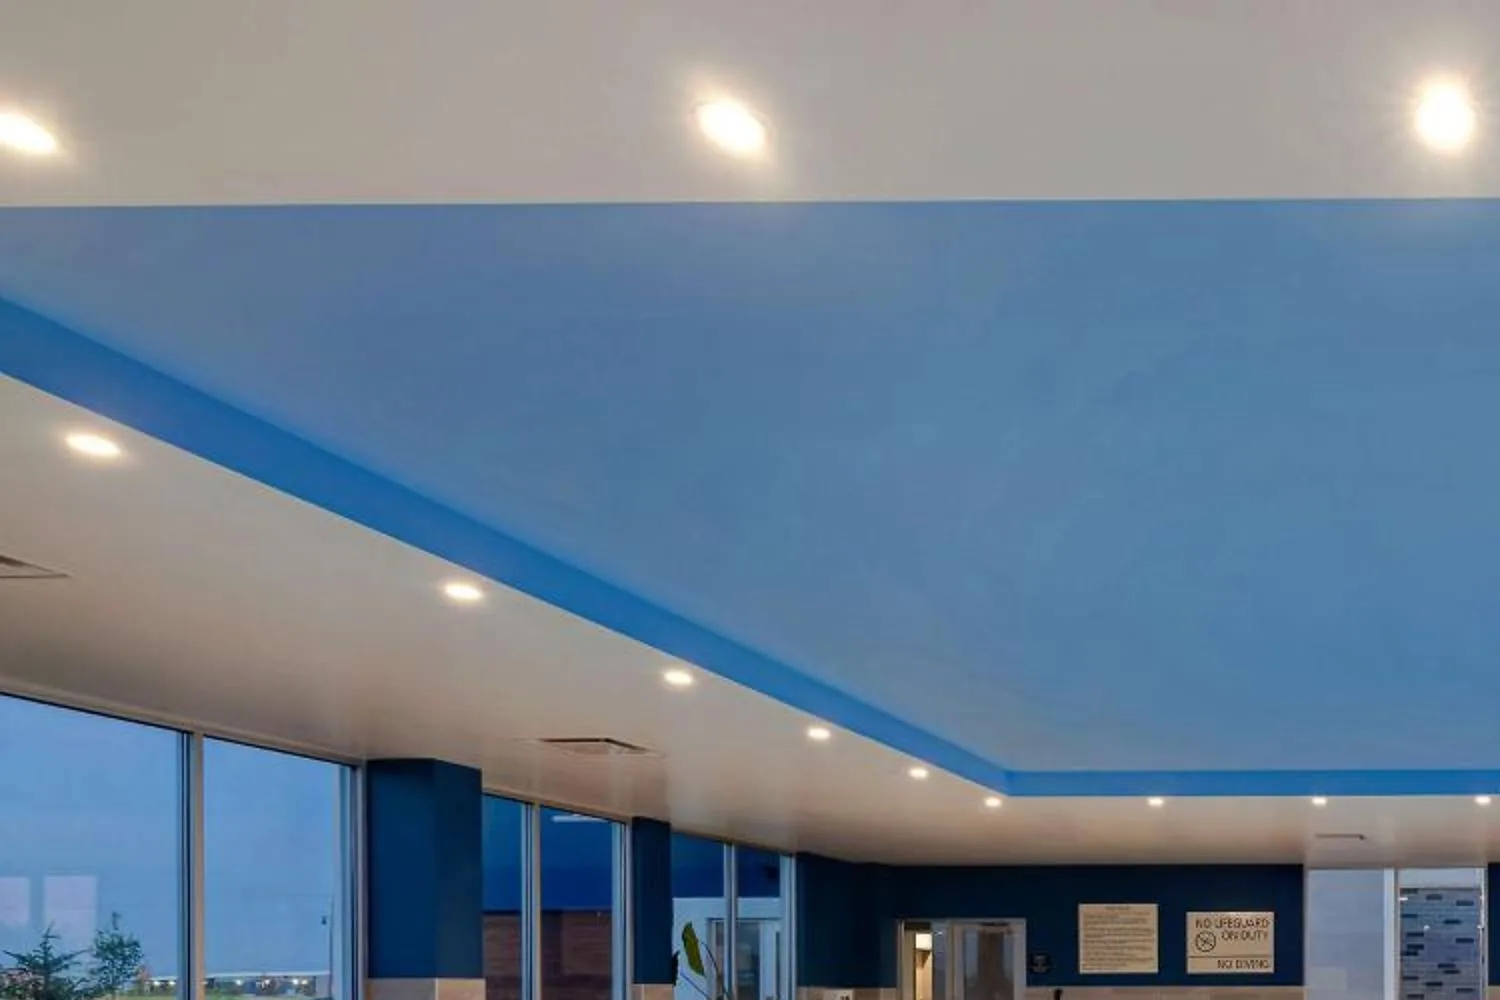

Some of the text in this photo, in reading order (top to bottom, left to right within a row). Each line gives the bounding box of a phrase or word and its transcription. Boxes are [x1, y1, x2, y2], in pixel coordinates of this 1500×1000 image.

[1195, 918, 1269, 928] NO LIFEGUARD
[1221, 929, 1268, 941] ON DUTY
[1217, 960, 1269, 969] NO DIVING
